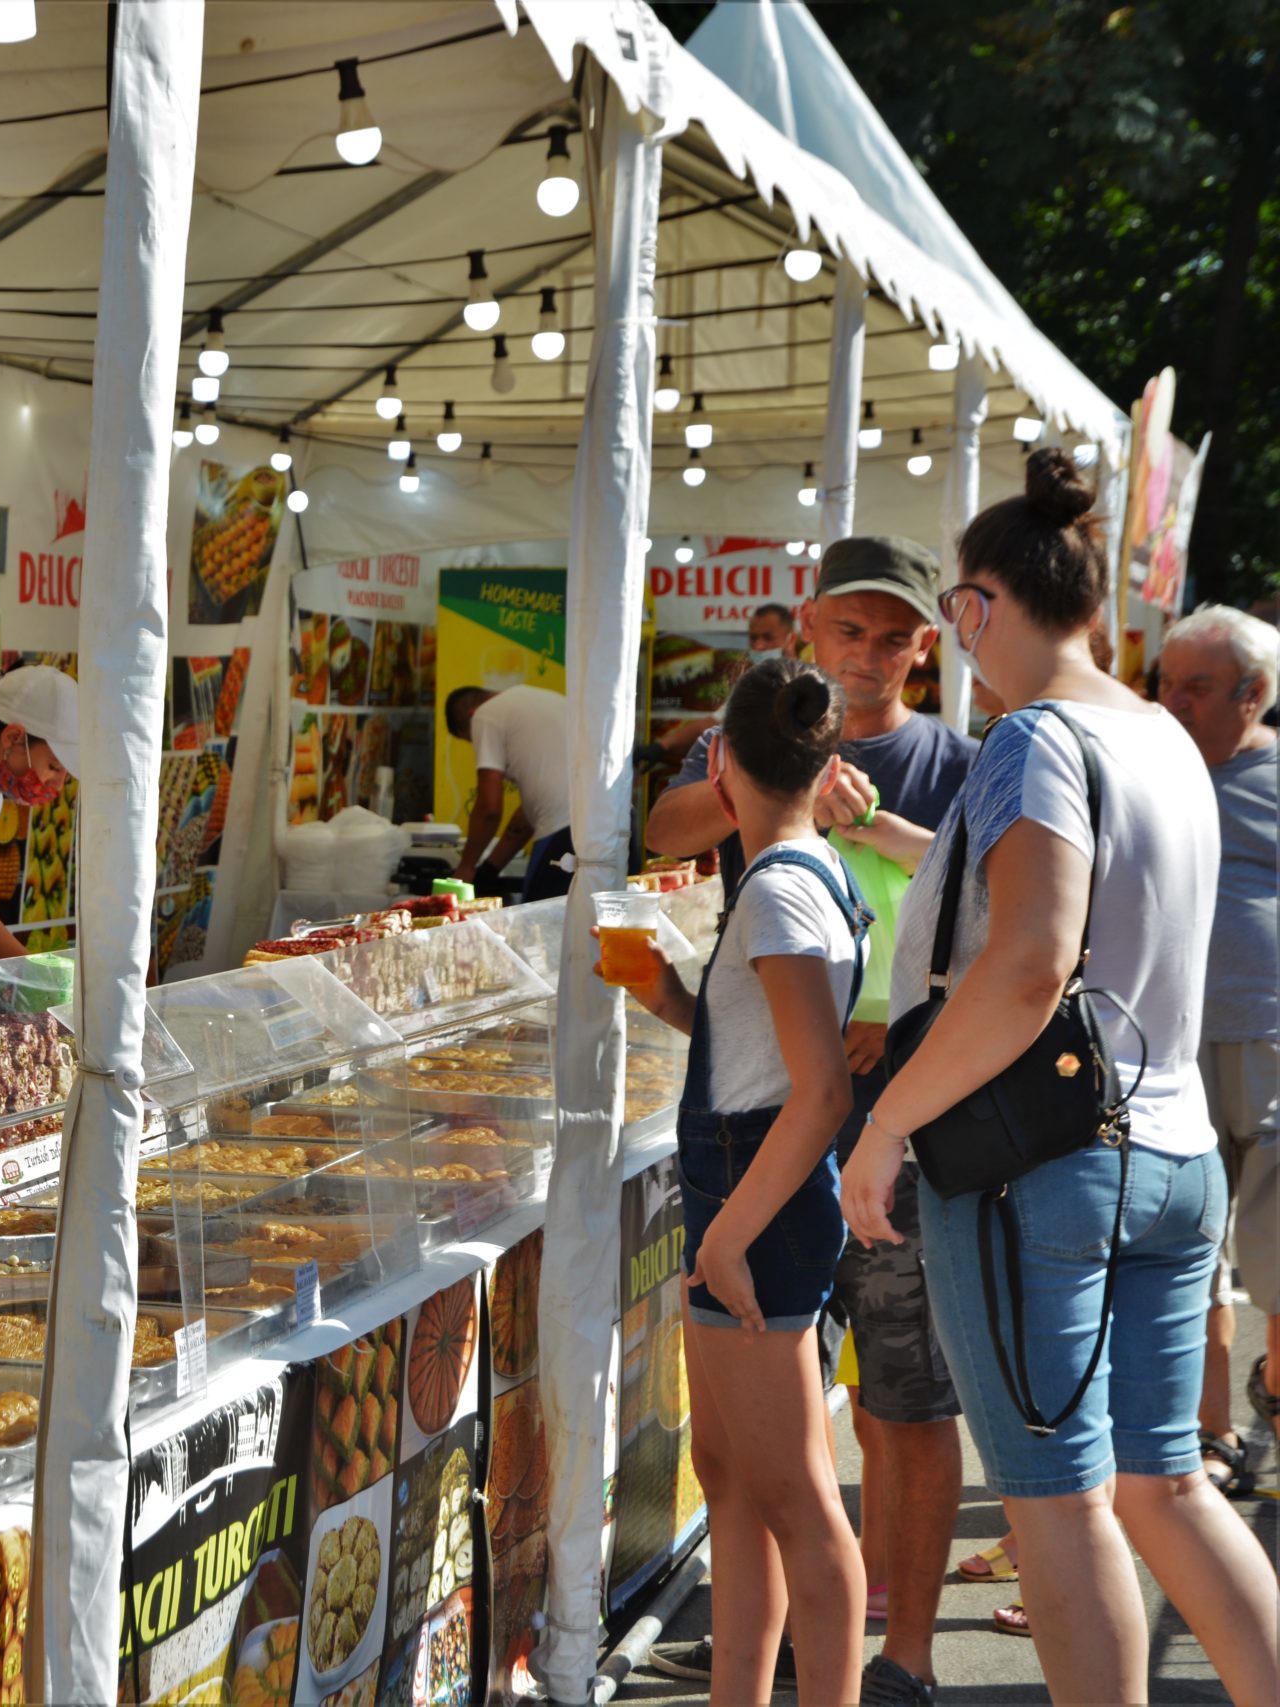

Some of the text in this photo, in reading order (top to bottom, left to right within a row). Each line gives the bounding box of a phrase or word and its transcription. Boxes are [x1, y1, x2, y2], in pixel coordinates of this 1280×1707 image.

[480, 581, 564, 615] HOMEMADE
[650, 566, 773, 598] DELICII
[498, 607, 537, 634] TASTE
